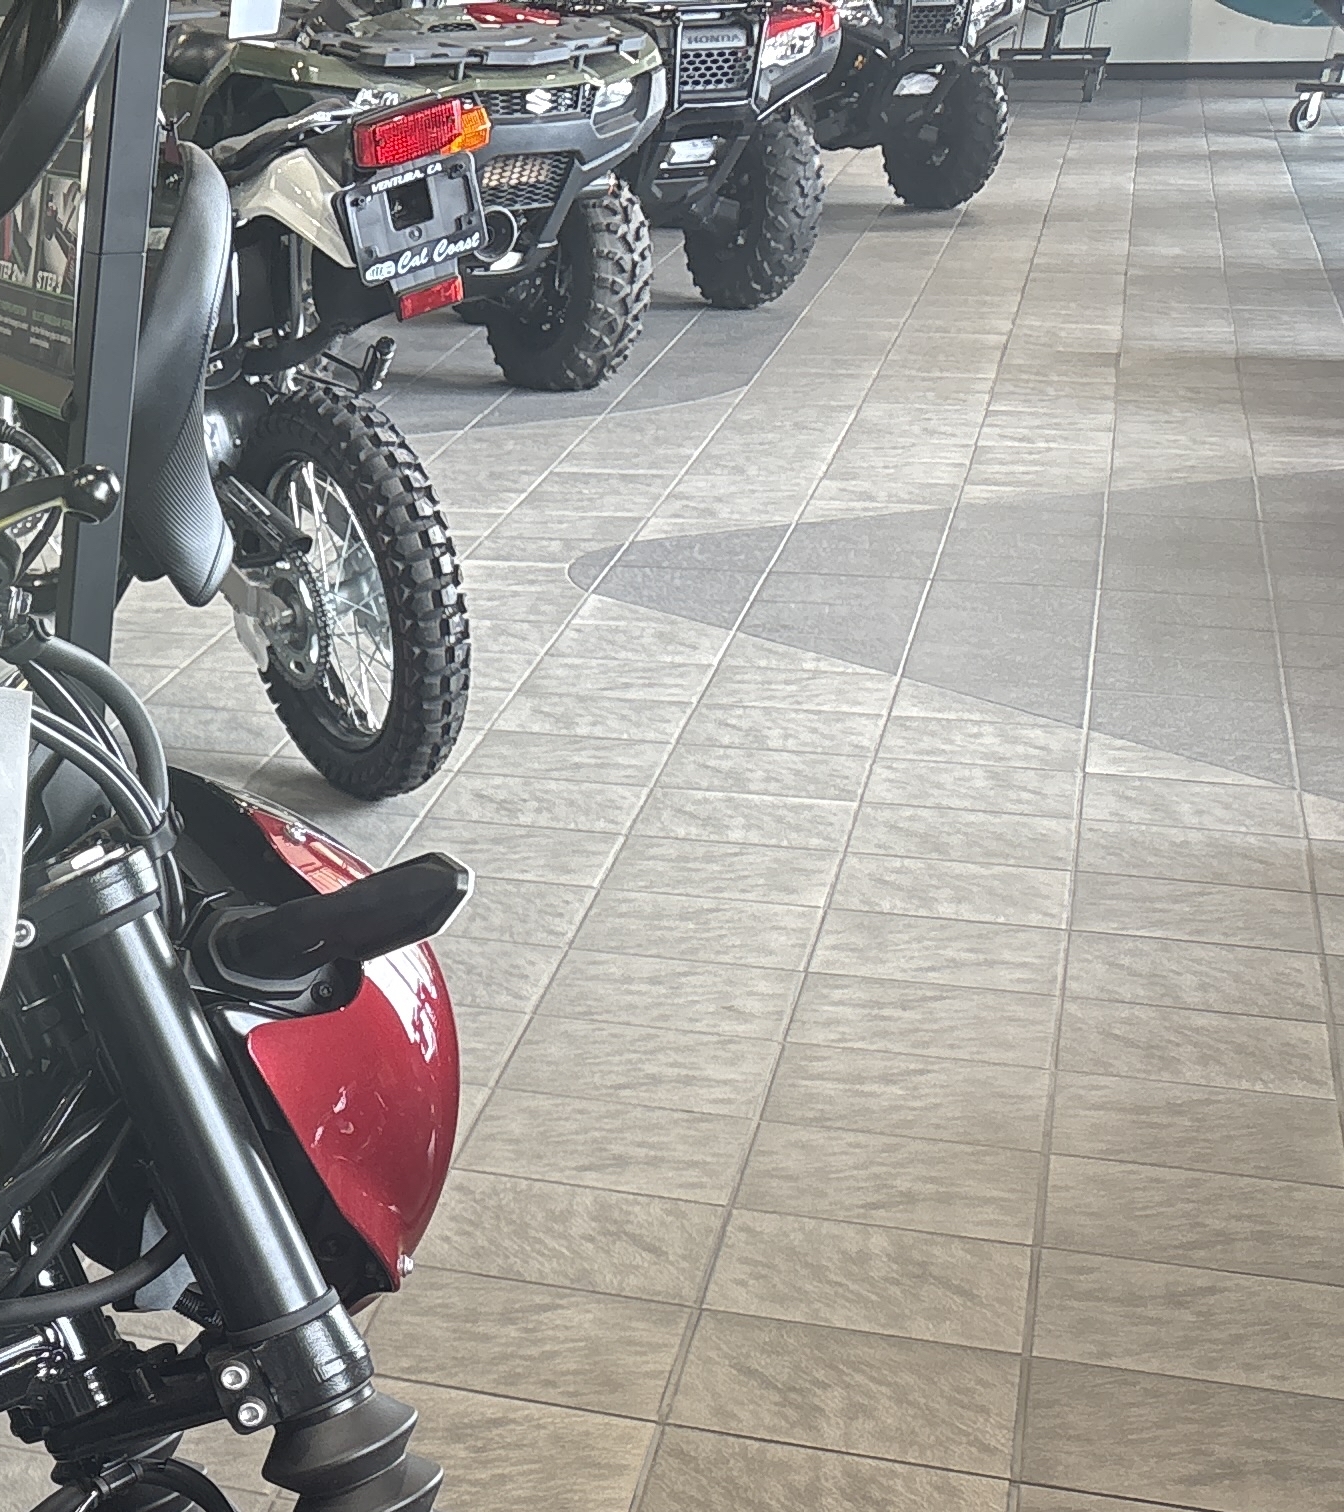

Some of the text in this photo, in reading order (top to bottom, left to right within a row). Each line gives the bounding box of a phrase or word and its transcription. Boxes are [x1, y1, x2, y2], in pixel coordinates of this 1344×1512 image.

[427, 162, 443, 175] CA
[397, 232, 480, 274] Cal Coast
